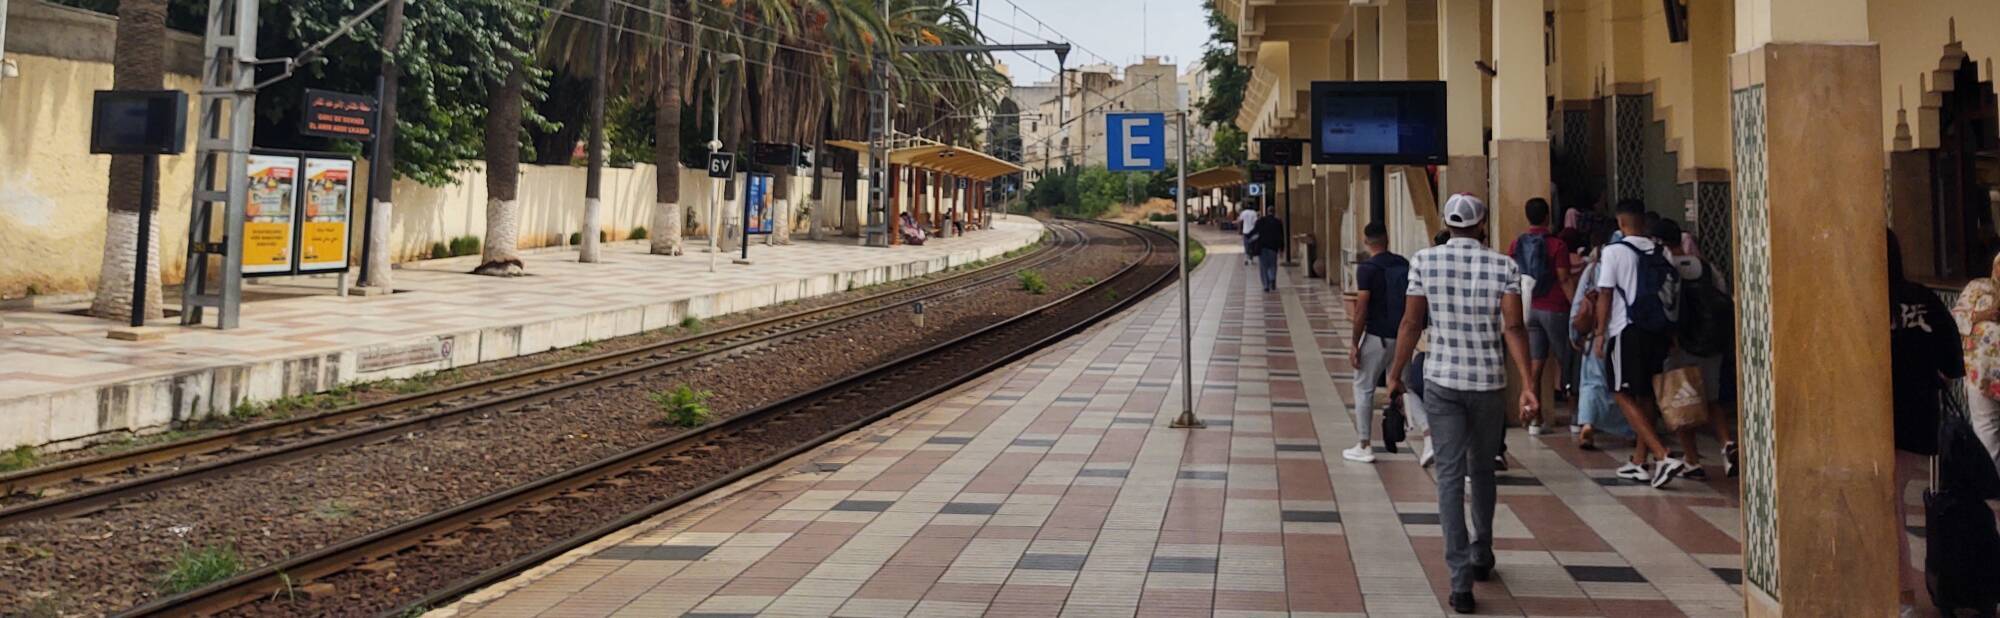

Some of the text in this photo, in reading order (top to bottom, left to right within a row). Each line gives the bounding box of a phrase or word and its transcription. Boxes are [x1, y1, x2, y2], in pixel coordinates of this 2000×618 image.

[1122, 118, 1151, 167] E
[711, 158, 730, 173] 6V
[1249, 184, 1260, 196] D
